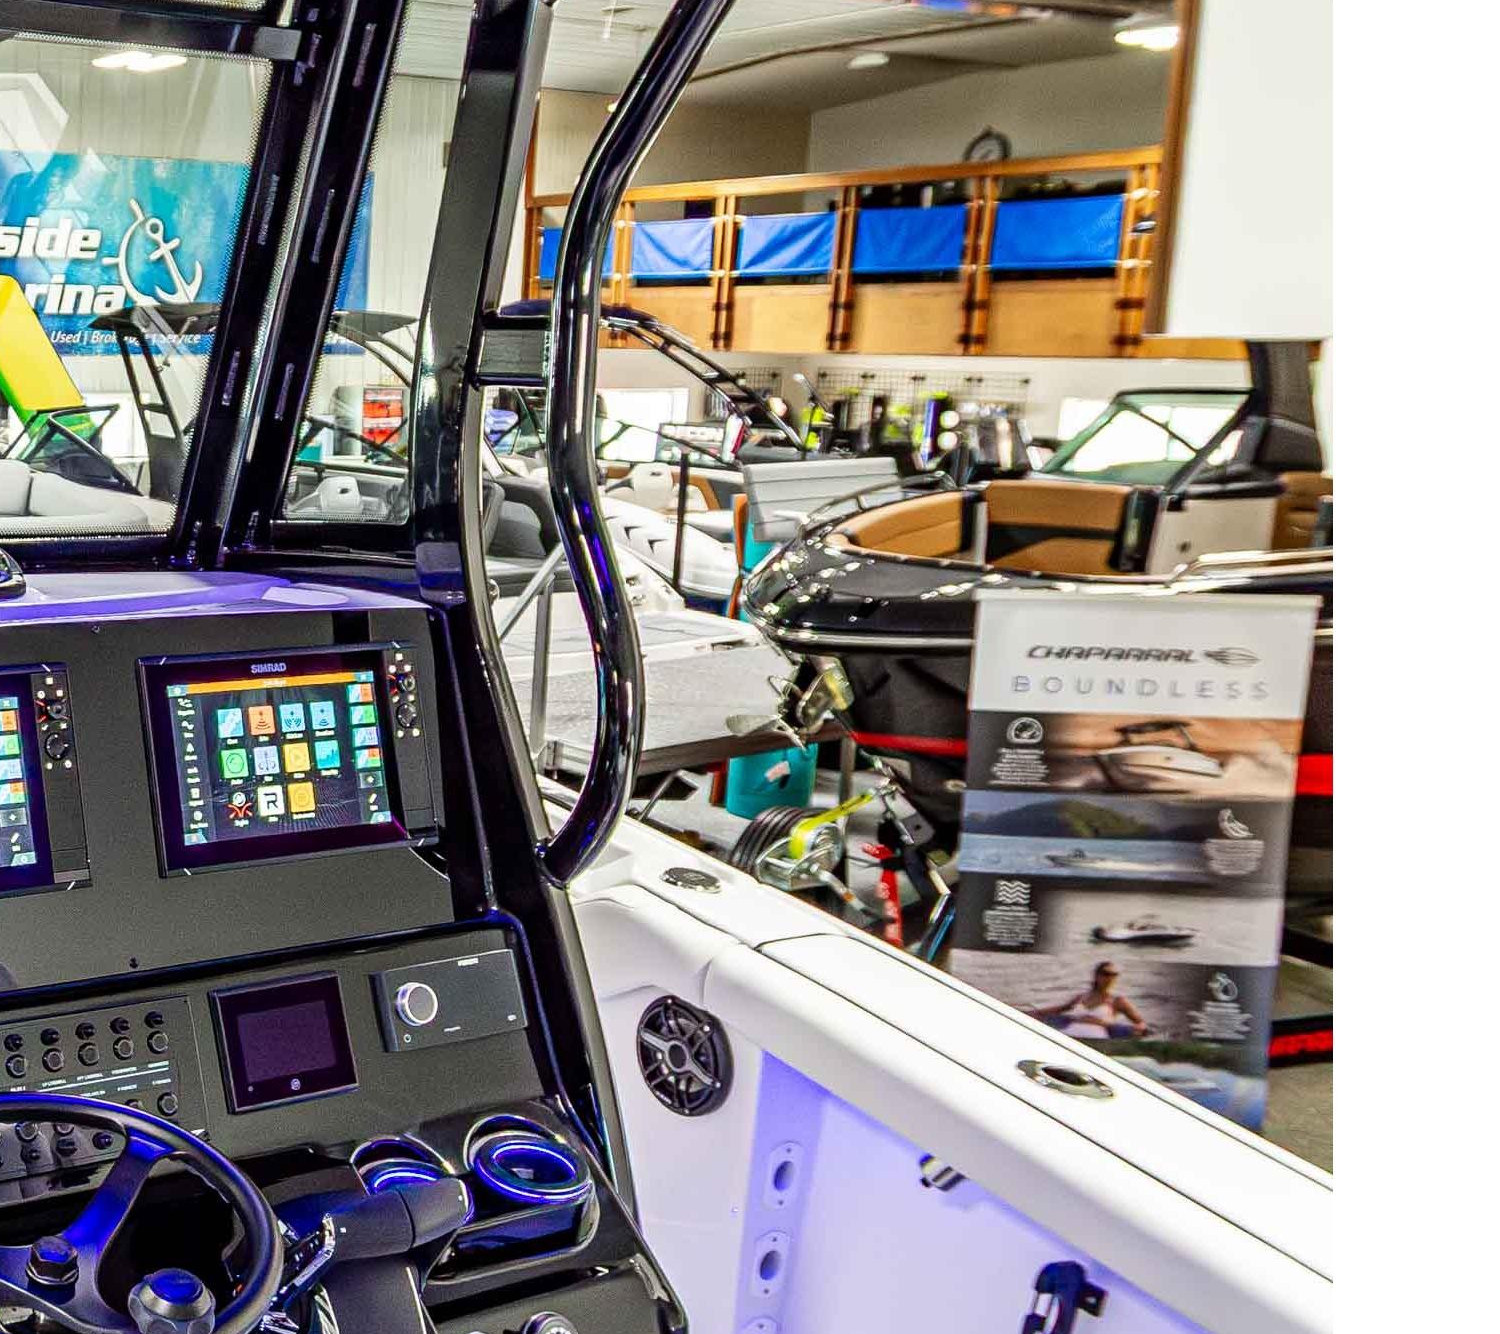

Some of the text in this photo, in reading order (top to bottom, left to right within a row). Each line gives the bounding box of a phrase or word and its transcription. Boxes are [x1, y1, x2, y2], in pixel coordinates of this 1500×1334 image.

[51, 330, 81, 343] Used
[1025, 644, 1199, 664] CHAPARRAL
[1011, 675, 1269, 699] BOUNDLESS
